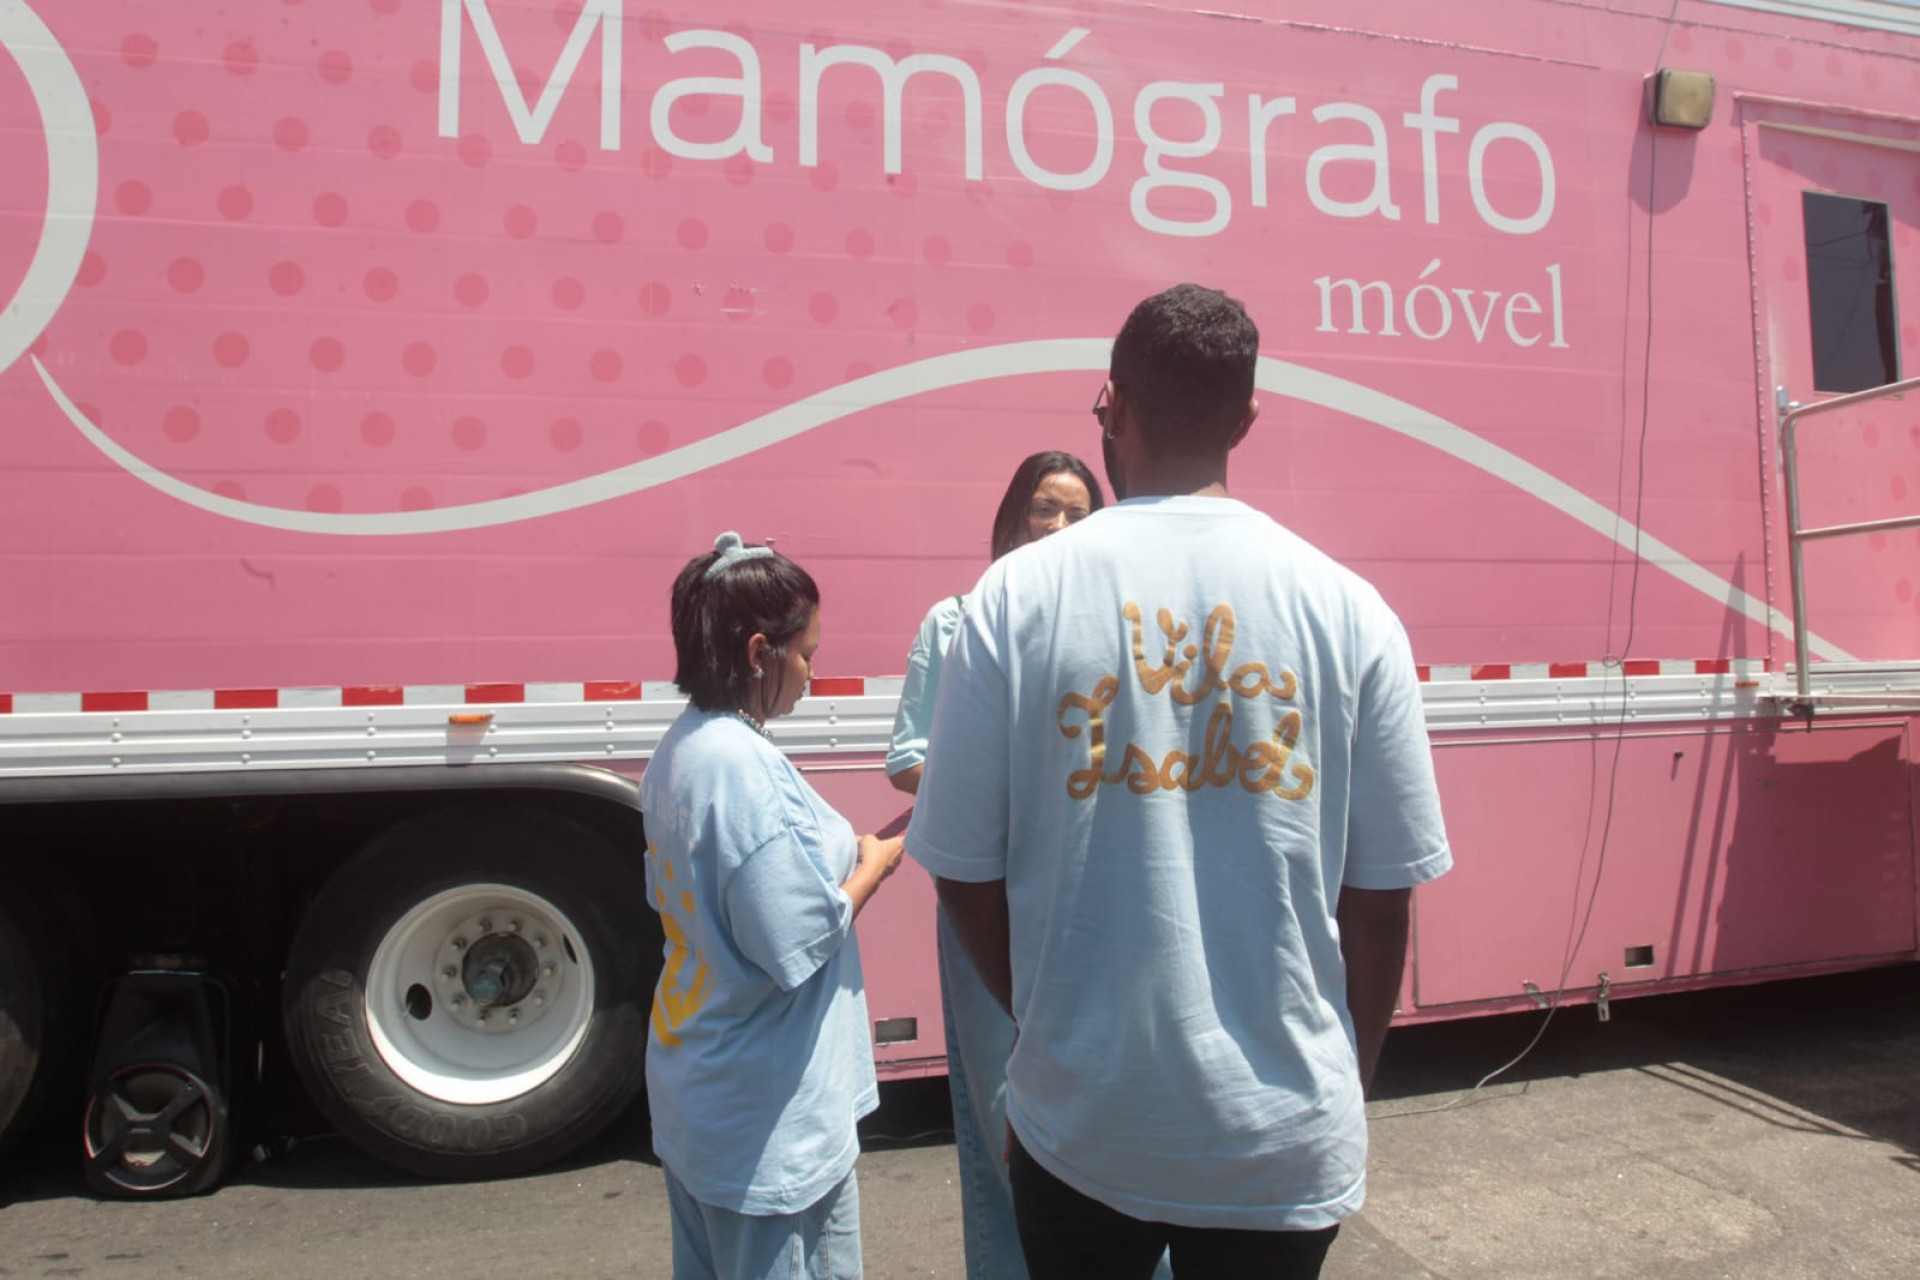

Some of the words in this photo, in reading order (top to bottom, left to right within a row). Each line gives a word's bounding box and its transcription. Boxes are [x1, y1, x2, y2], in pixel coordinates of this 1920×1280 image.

[437, 0, 1557, 237] Mamógrafo
[1313, 258, 1571, 349] móvel
[1122, 599, 1298, 706] Vila
[1056, 674, 1315, 801] Isabel
